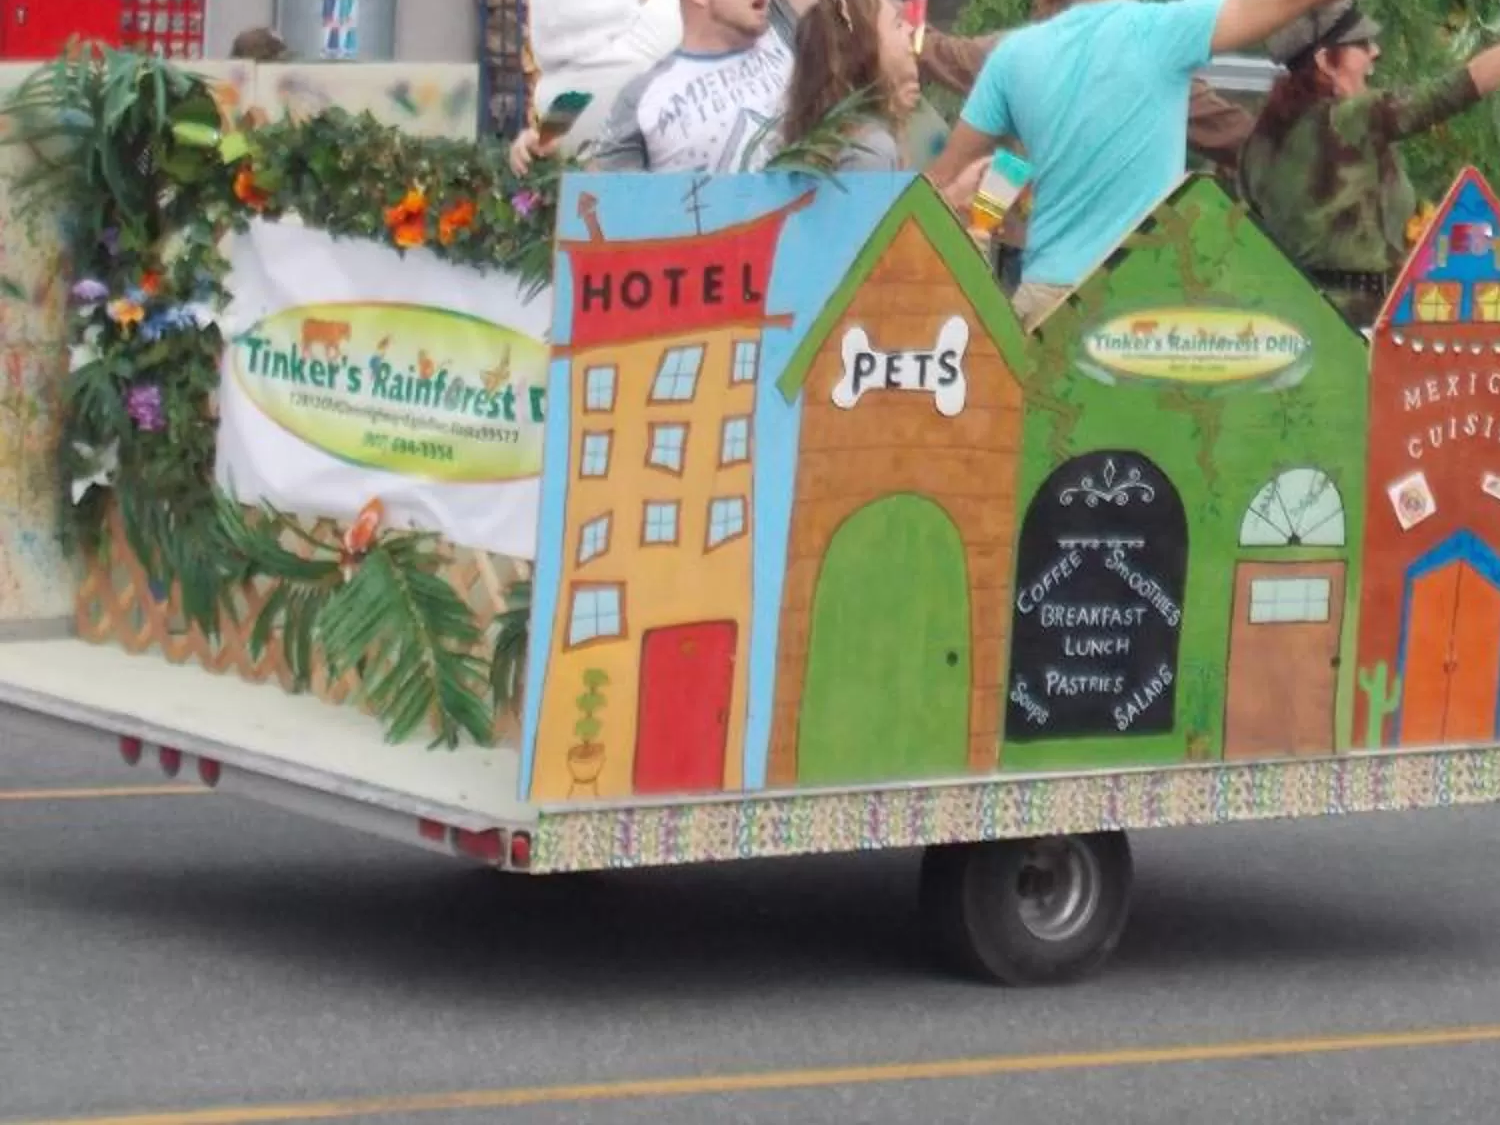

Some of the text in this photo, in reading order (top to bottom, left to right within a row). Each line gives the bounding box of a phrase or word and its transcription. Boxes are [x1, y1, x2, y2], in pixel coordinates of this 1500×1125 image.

[581, 263, 763, 312] HOTEL
[244, 336, 362, 395] Tinker's
[371, 362, 516, 422] Rainforest
[851, 350, 959, 395] PETS
[1017, 550, 1083, 614] COFFEE
[1041, 604, 1148, 628] BREAKFAST
[1064, 636, 1130, 657] LUNCH
[1045, 671, 1125, 695] PASTRIES
[1113, 662, 1173, 731] SALADS
